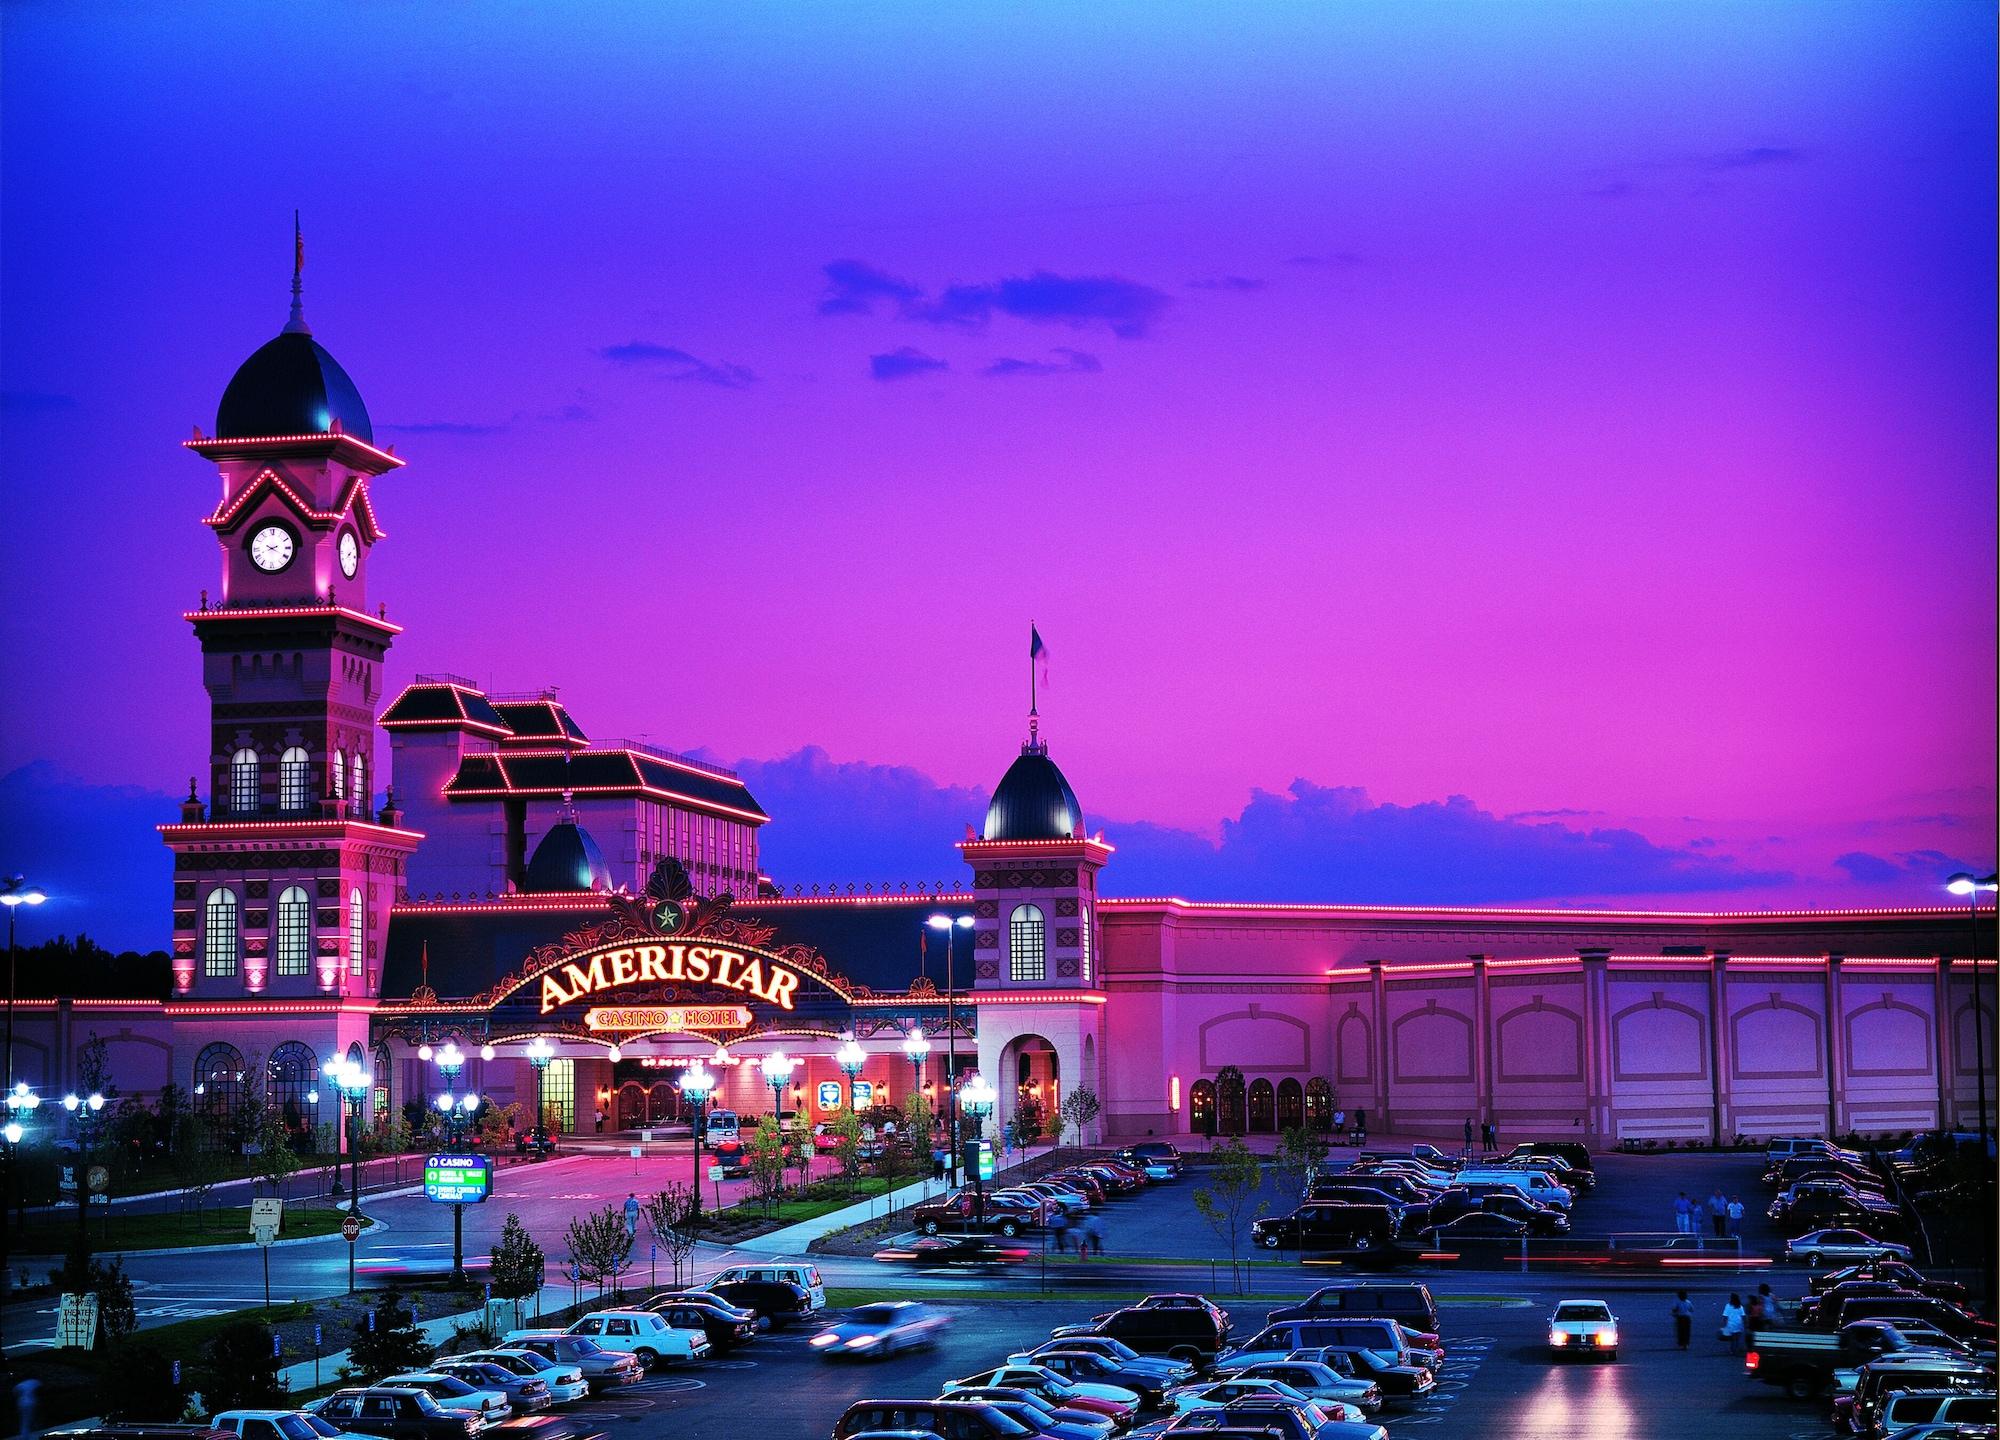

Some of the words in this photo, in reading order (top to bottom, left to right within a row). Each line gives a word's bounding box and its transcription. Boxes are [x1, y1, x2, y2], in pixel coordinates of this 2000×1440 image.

[540, 945, 799, 1014] AMERISTAR
[597, 1011, 669, 1026] CASINO
[684, 1011, 741, 1026] HOTEL
[440, 1158, 474, 1167] CASINO
[343, 1224, 359, 1234] STOP
[63, 1309, 94, 1317] THEATER
